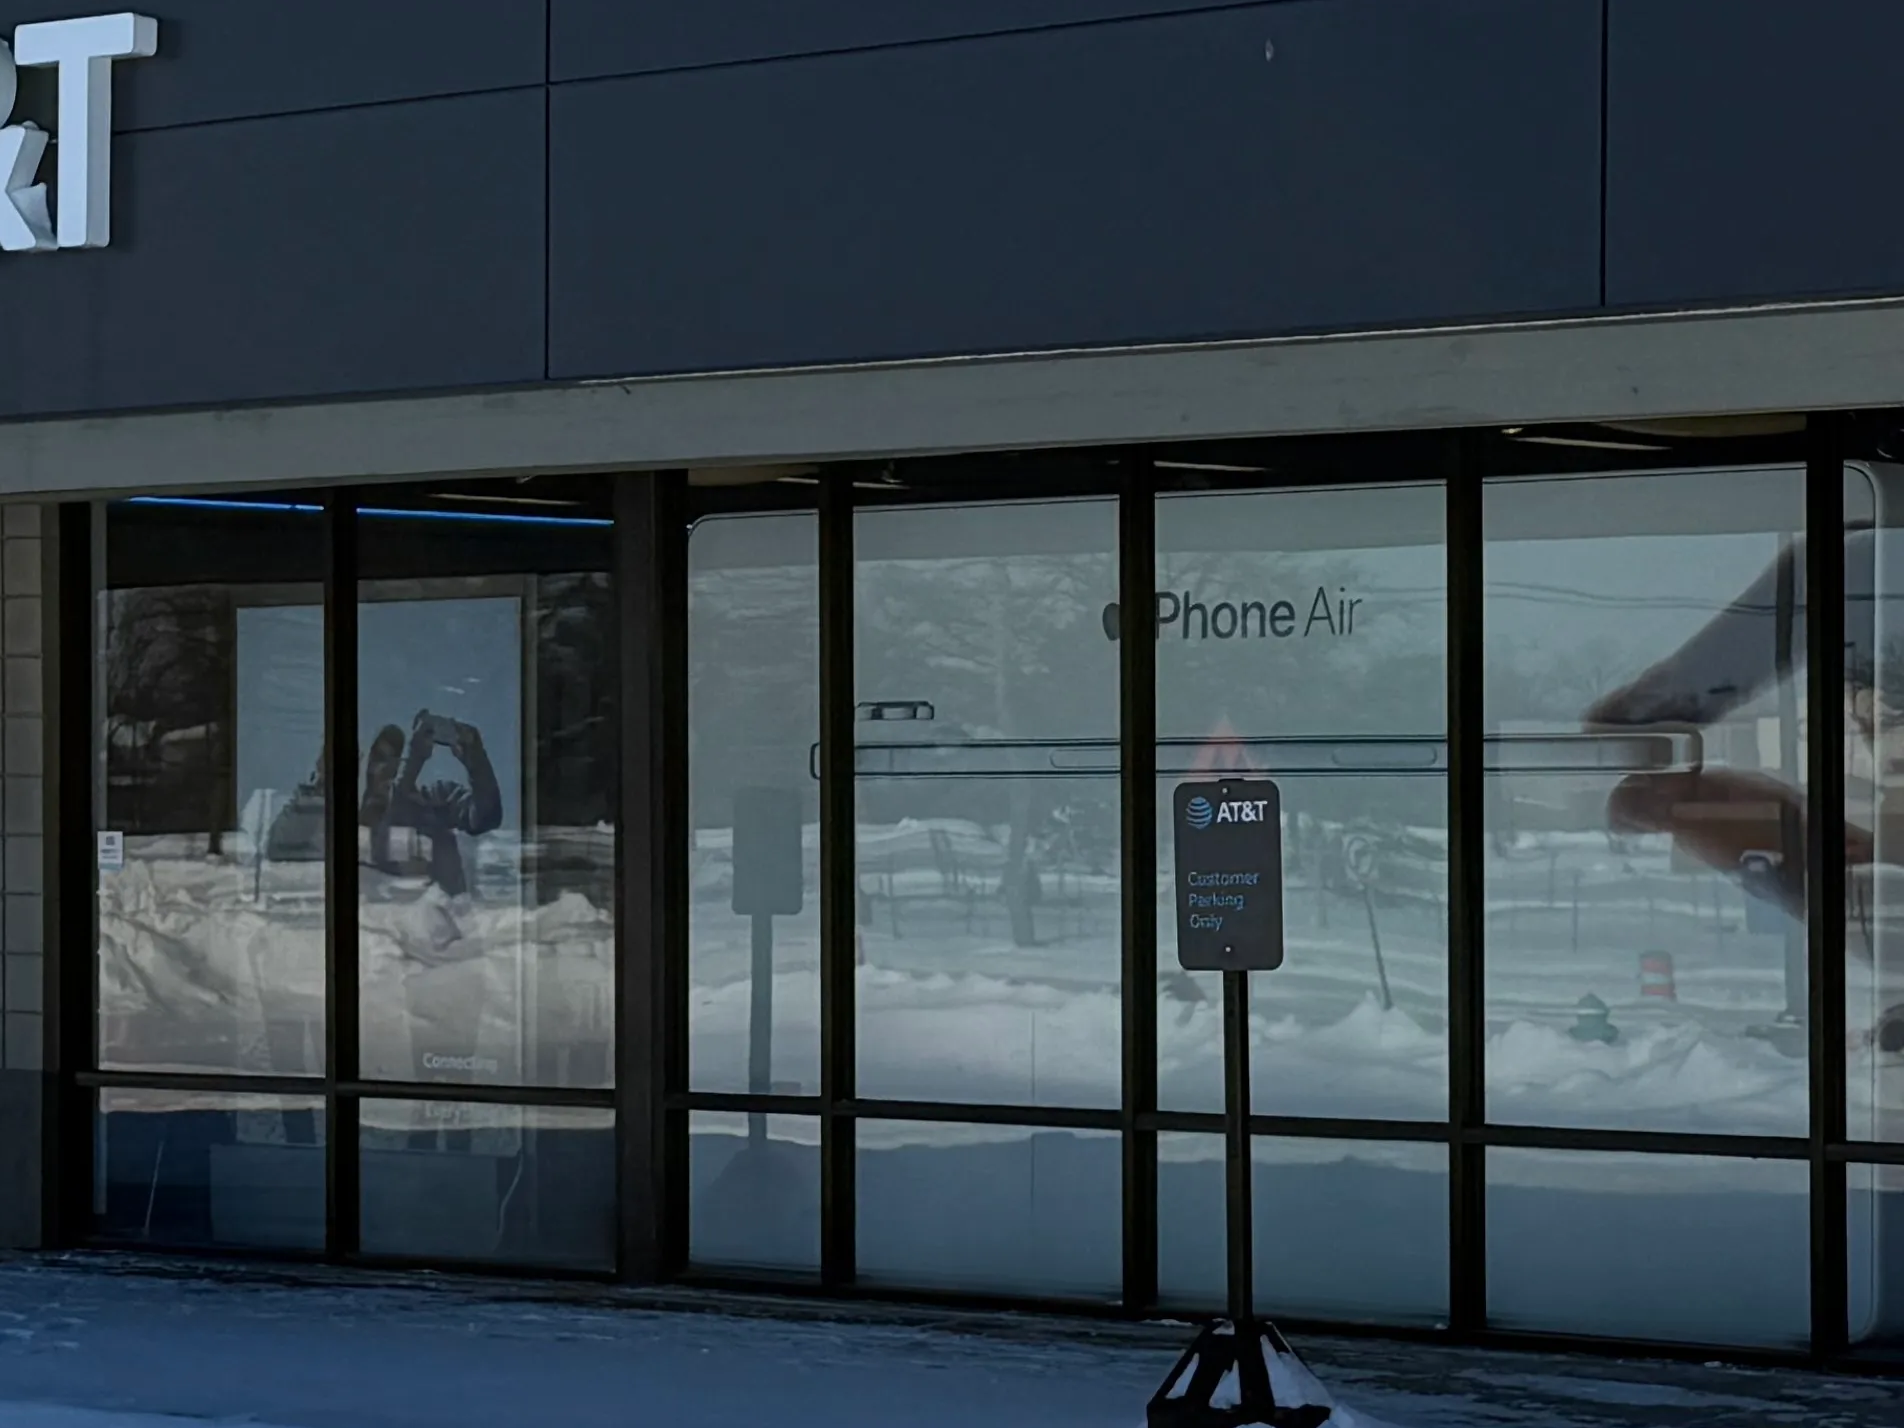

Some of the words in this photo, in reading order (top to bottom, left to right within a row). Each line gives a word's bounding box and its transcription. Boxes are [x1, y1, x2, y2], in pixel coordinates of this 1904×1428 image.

[1156, 590, 1295, 640] Phone
[1303, 586, 1364, 637] Air
[1216, 800, 1268, 823] AT&T
[1187, 871, 1260, 887] Customer
[1188, 892, 1245, 912] Parking
[1189, 913, 1223, 932] Only
